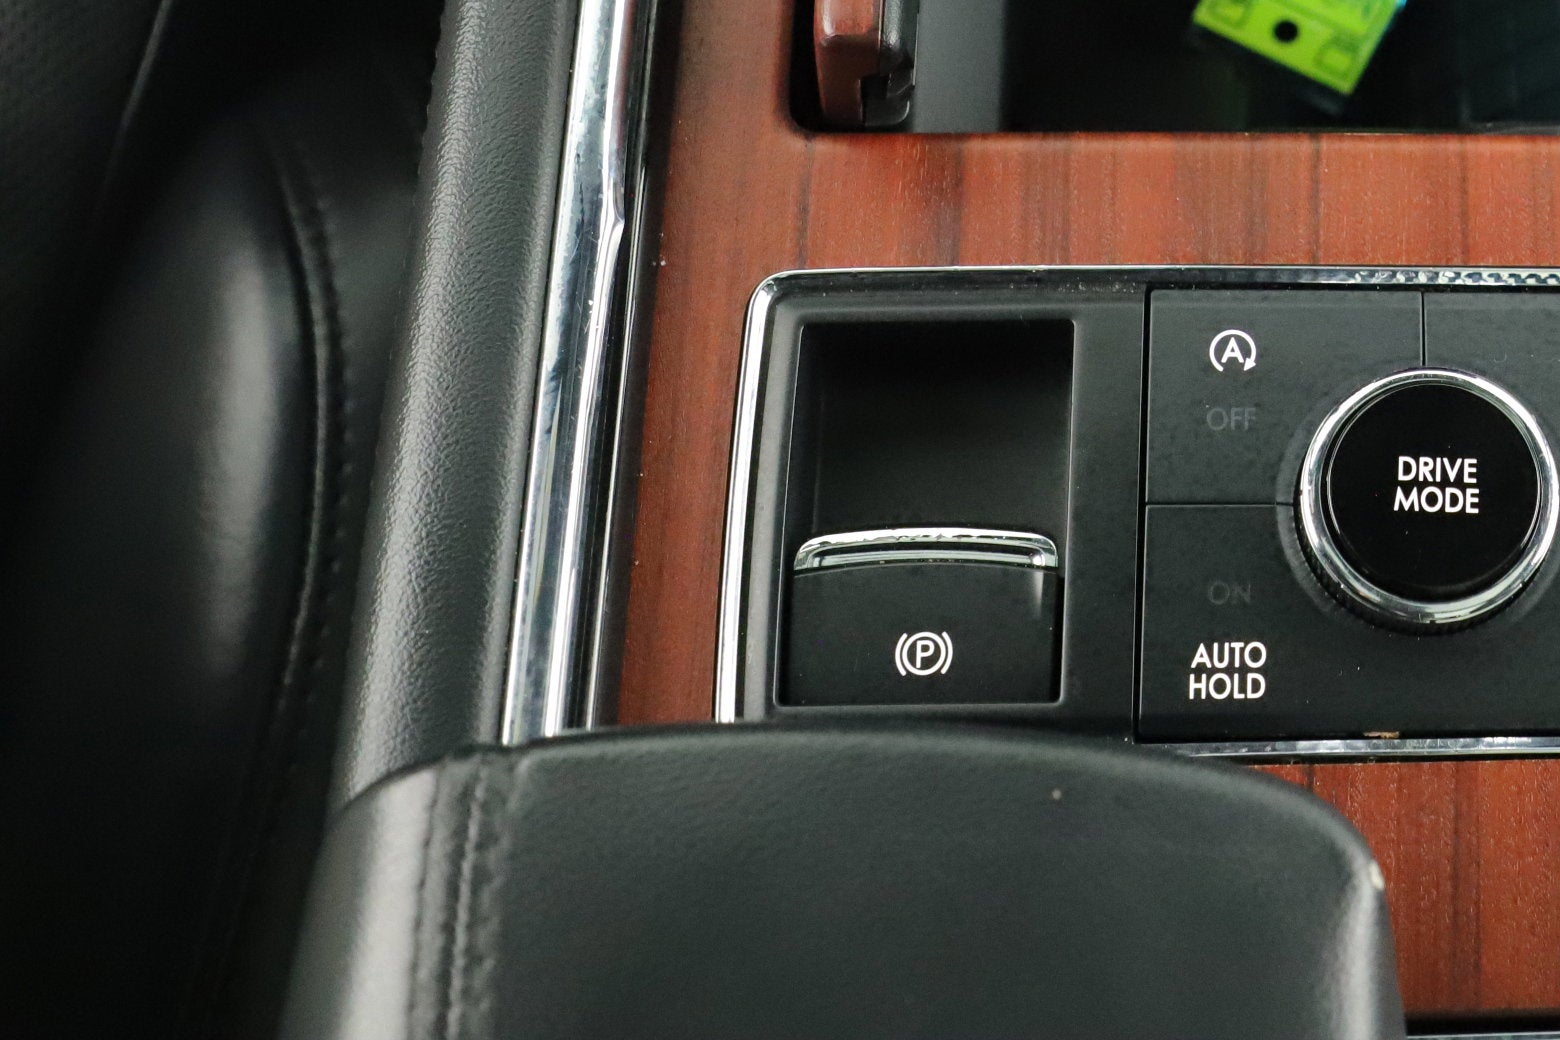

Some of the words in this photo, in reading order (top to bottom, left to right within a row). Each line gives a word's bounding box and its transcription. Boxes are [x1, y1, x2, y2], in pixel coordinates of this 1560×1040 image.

[1206, 406, 1257, 431] OFF
[1397, 455, 1478, 484] DRIVE
[1393, 485, 1480, 514] MODE
[1208, 580, 1252, 605] ON
[1190, 641, 1267, 669] AUTO
[1188, 672, 1266, 700] HOLD
